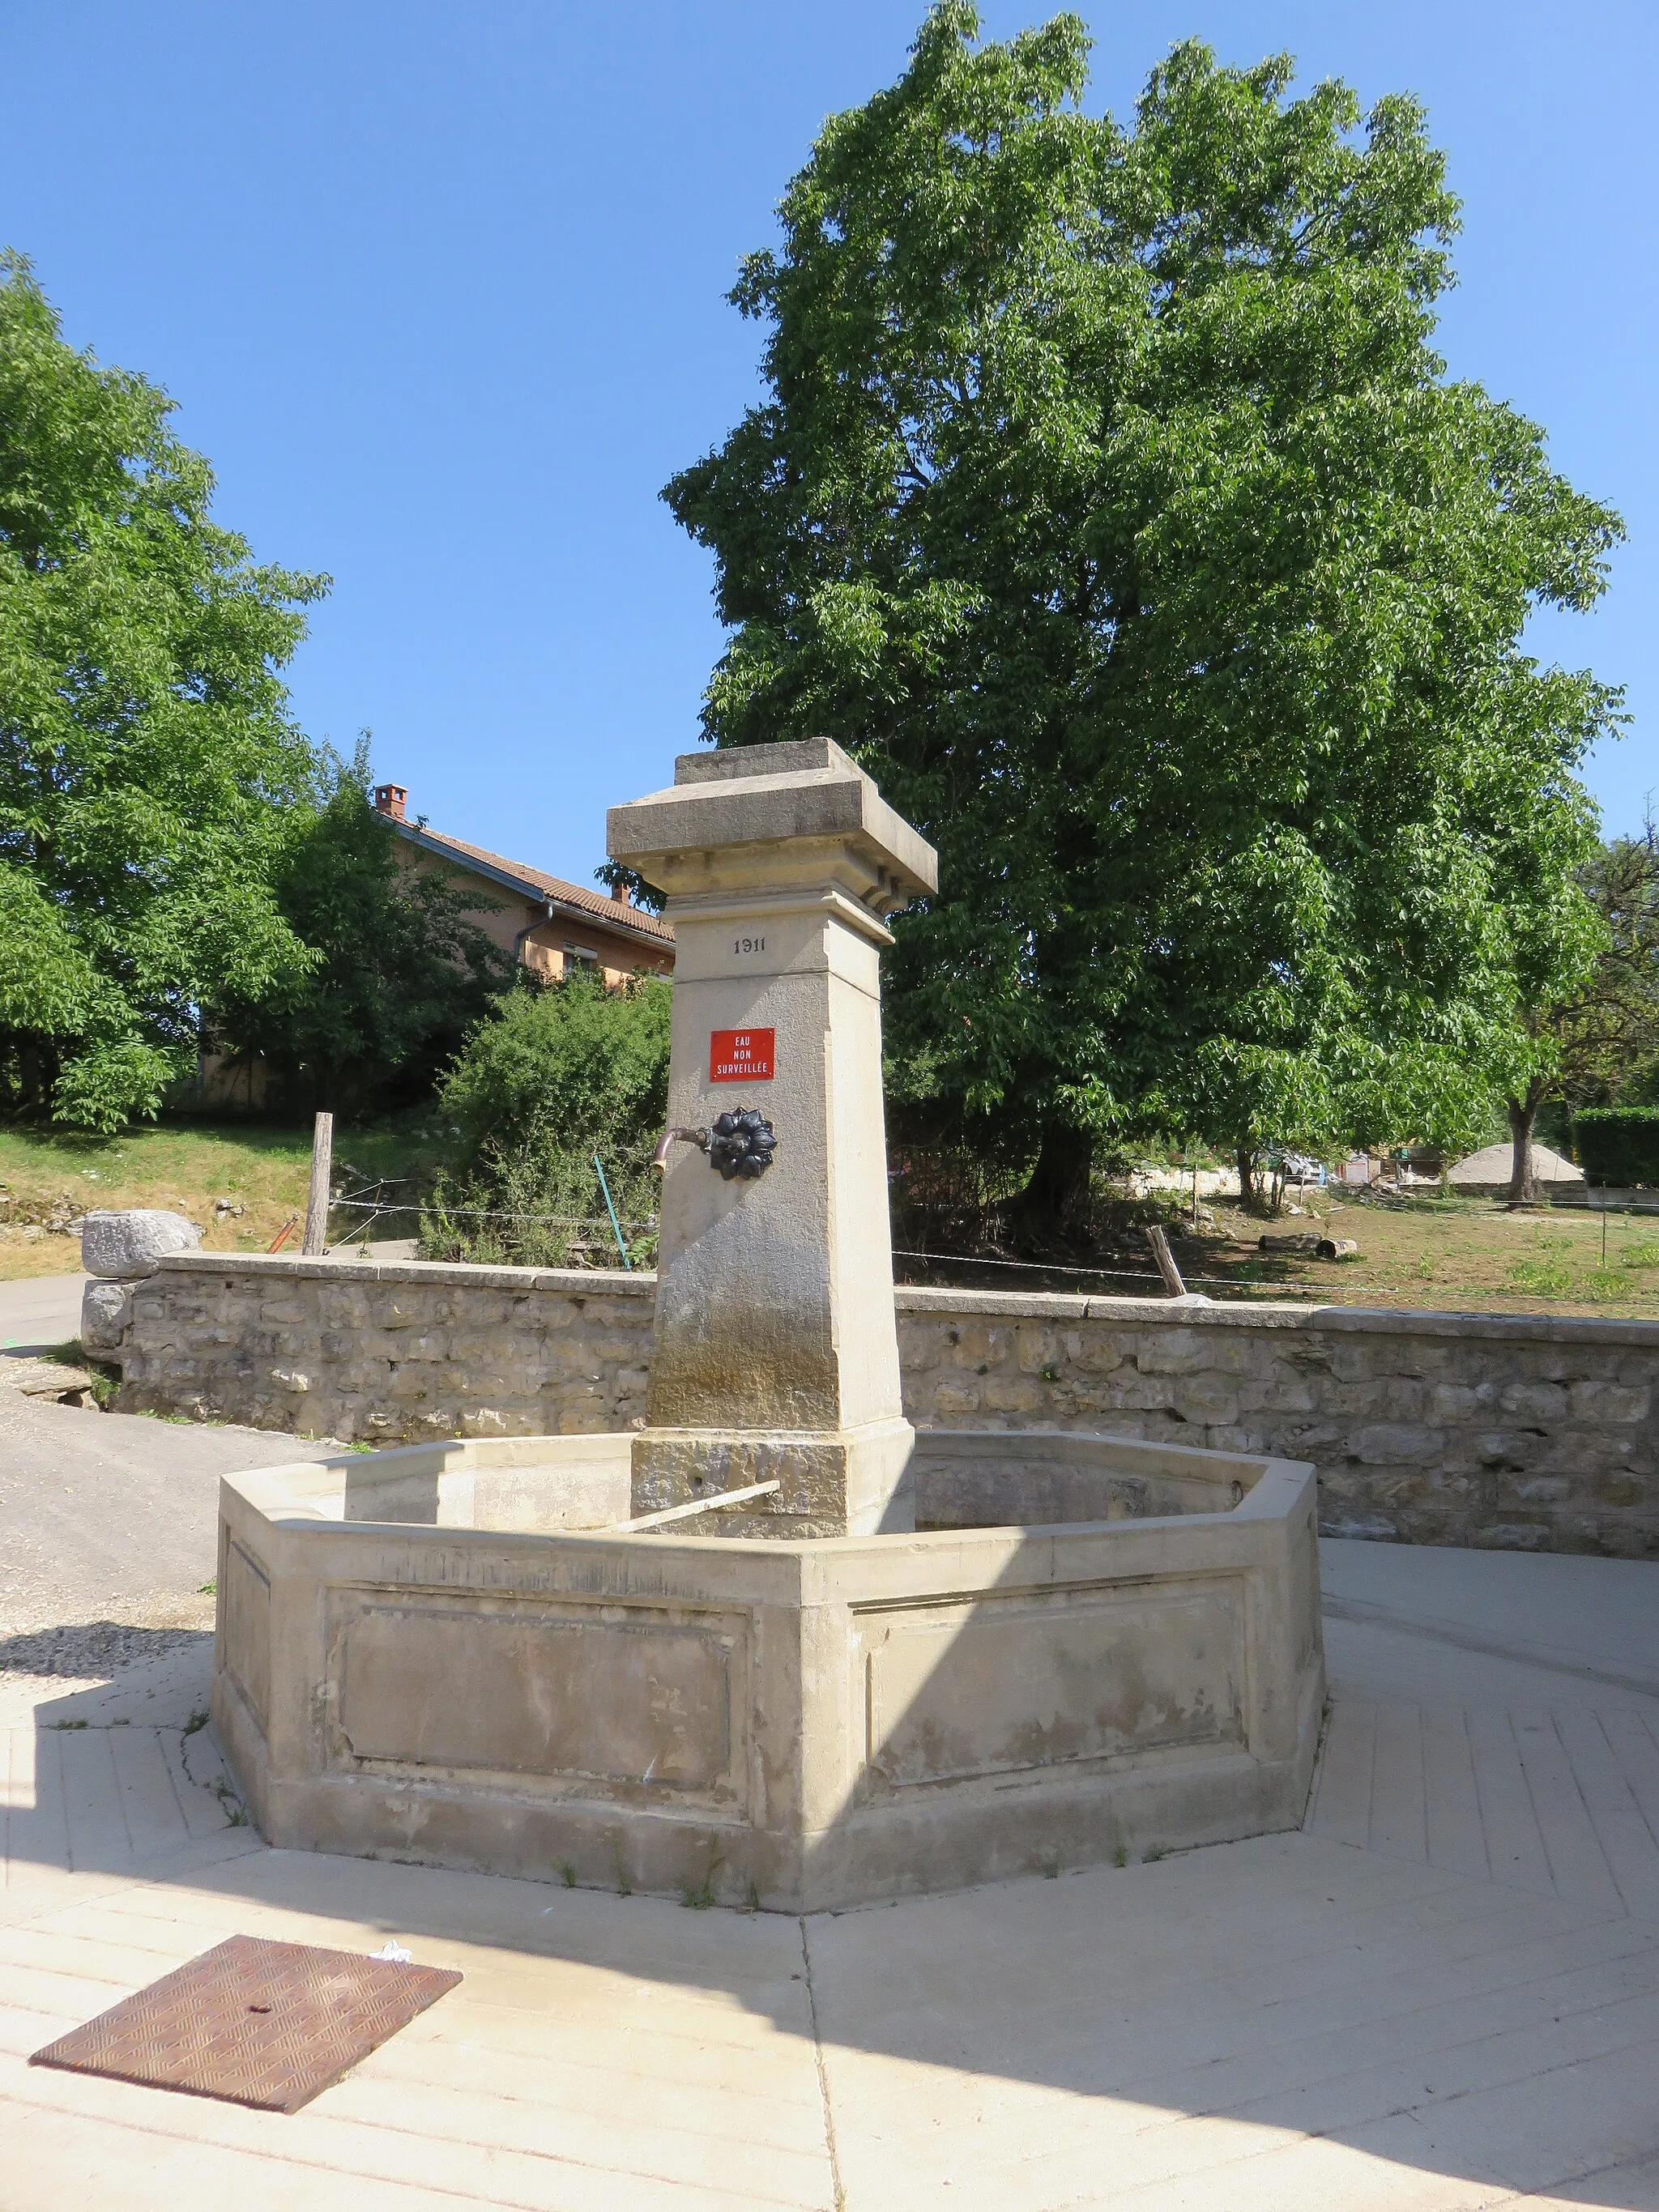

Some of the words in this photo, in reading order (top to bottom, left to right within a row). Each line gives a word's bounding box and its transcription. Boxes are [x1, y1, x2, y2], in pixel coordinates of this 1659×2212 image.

[734, 938, 766, 954] 1911
[735, 1037, 750, 1046] EAU
[733, 1051, 751, 1060] NON
[717, 1061, 767, 1075] SURVEILLÉE
